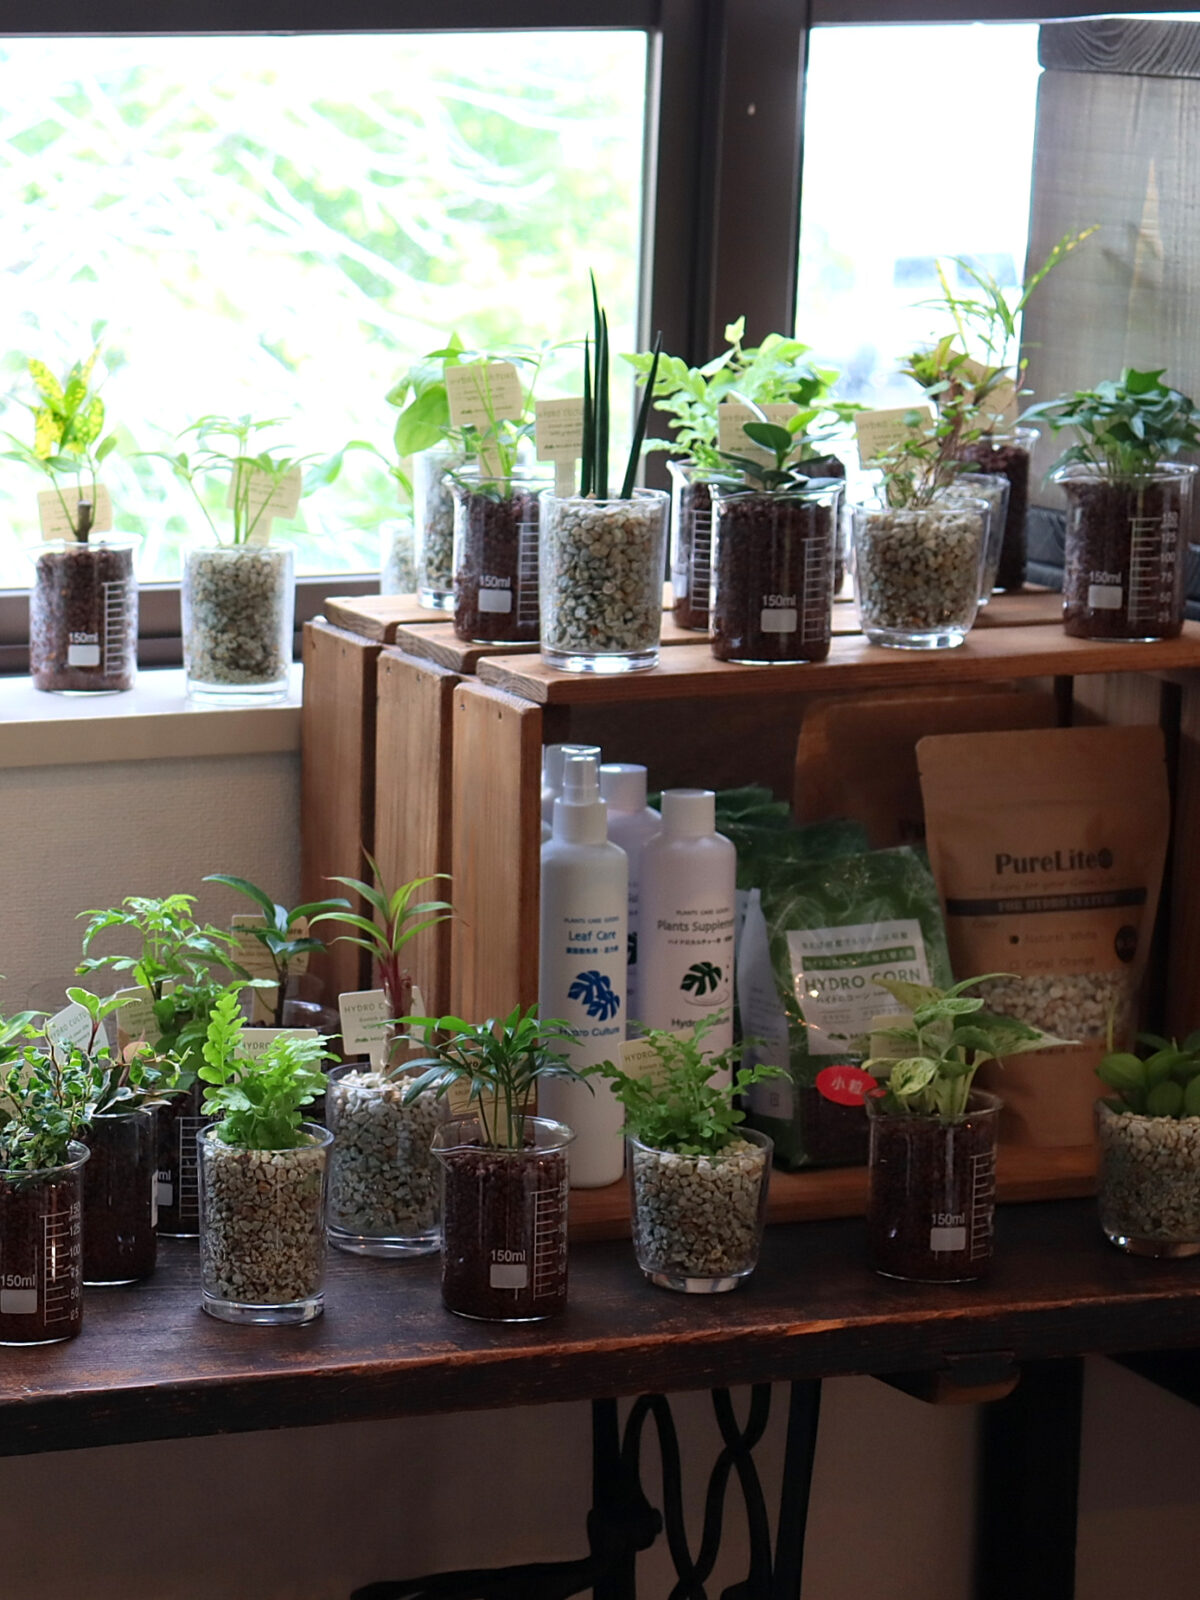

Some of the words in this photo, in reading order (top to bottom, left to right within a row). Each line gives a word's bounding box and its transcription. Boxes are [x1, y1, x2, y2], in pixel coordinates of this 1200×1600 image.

[480, 576, 511, 588] 150ml
[1088, 572, 1122, 584] 150ml
[762, 595, 797, 607] 150ml
[69, 632, 99, 644] 150ml
[995, 850, 1099, 875] PureLite
[657, 919, 689, 932] Plants
[568, 930, 593, 942] Leaf
[596, 930, 616, 942] Care
[804, 975, 865, 992] HYDRO
[344, 1003, 375, 1014] HYDRO
[931, 1212, 965, 1225] 150ml
[70, 1243, 81, 1258] 100
[490, 1250, 526, 1263] 150ml
[0, 1274, 36, 1287] 150ml
[70, 1286, 80, 1300] 50
